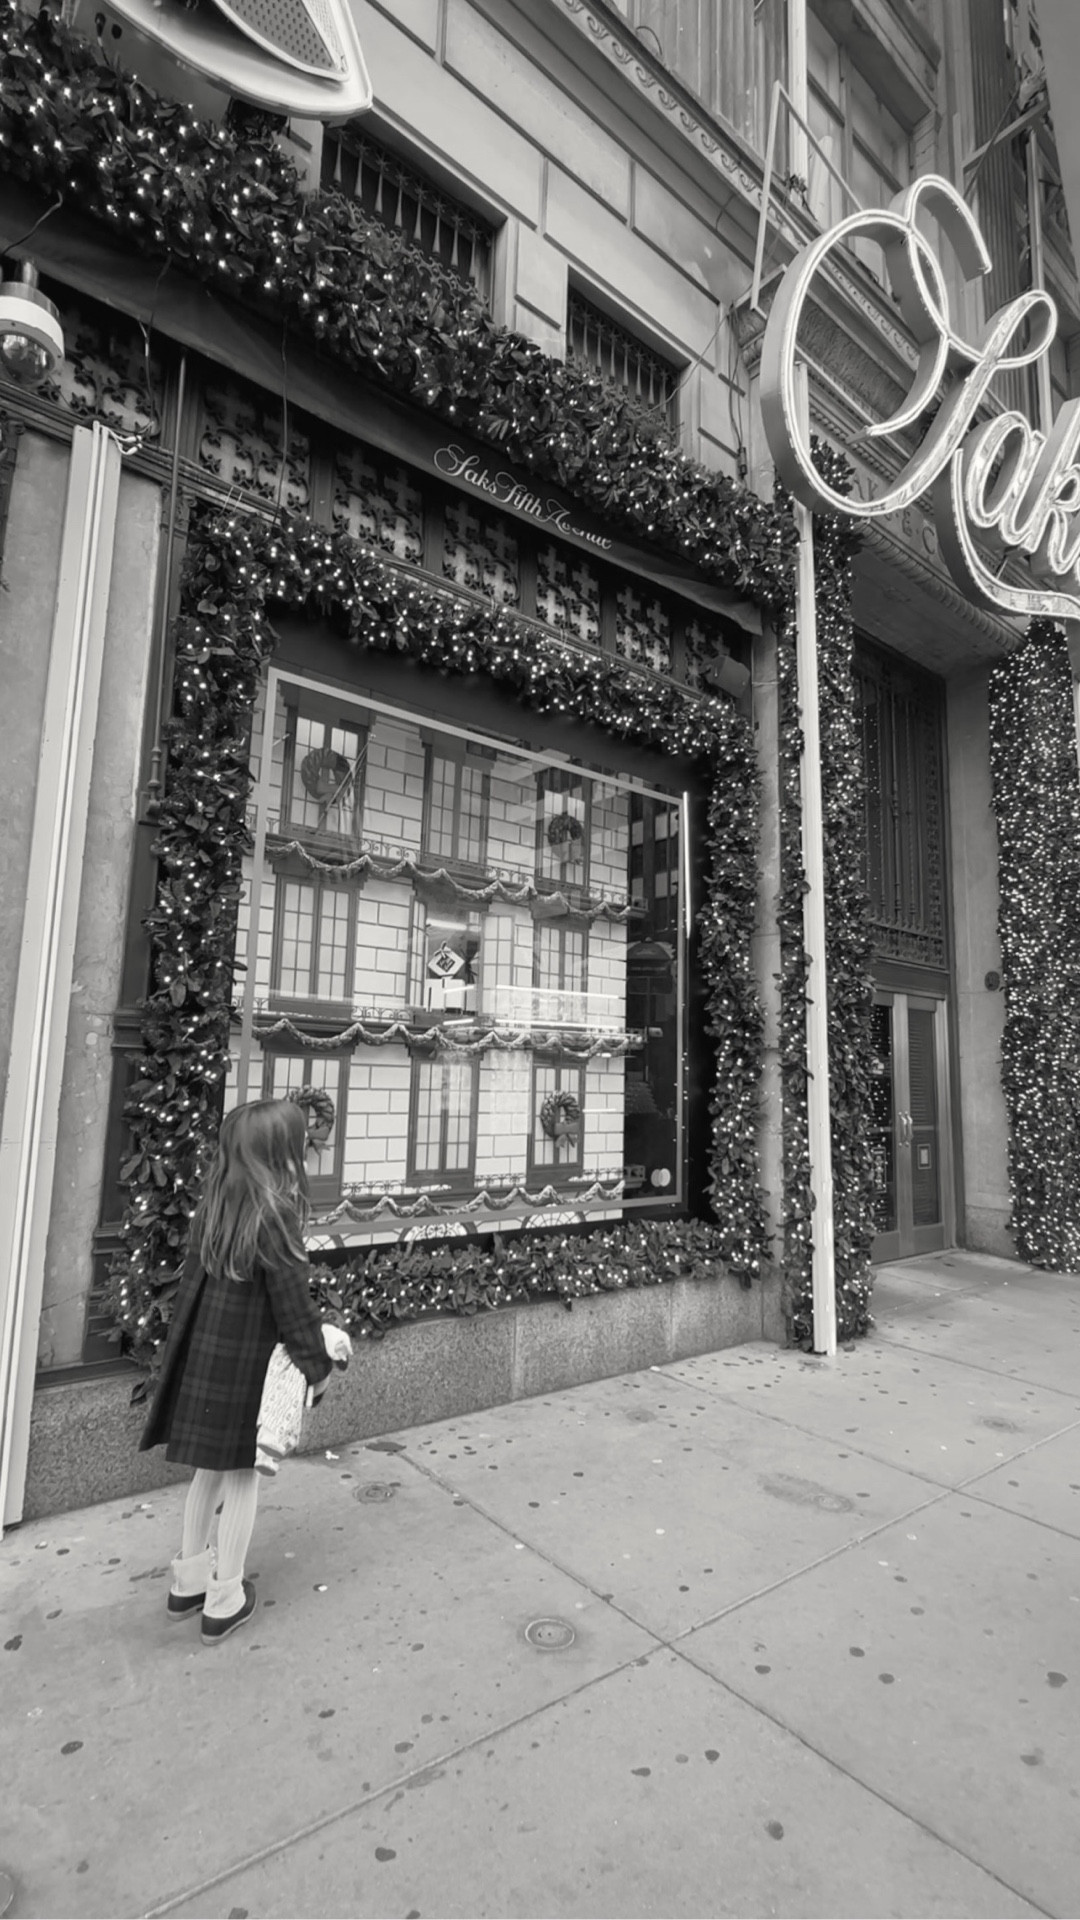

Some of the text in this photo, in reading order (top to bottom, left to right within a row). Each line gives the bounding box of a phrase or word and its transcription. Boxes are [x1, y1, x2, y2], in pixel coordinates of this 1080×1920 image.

[764, 173, 1080, 565] Sak
[433, 443, 613, 550] Saks Fifth Avenue
